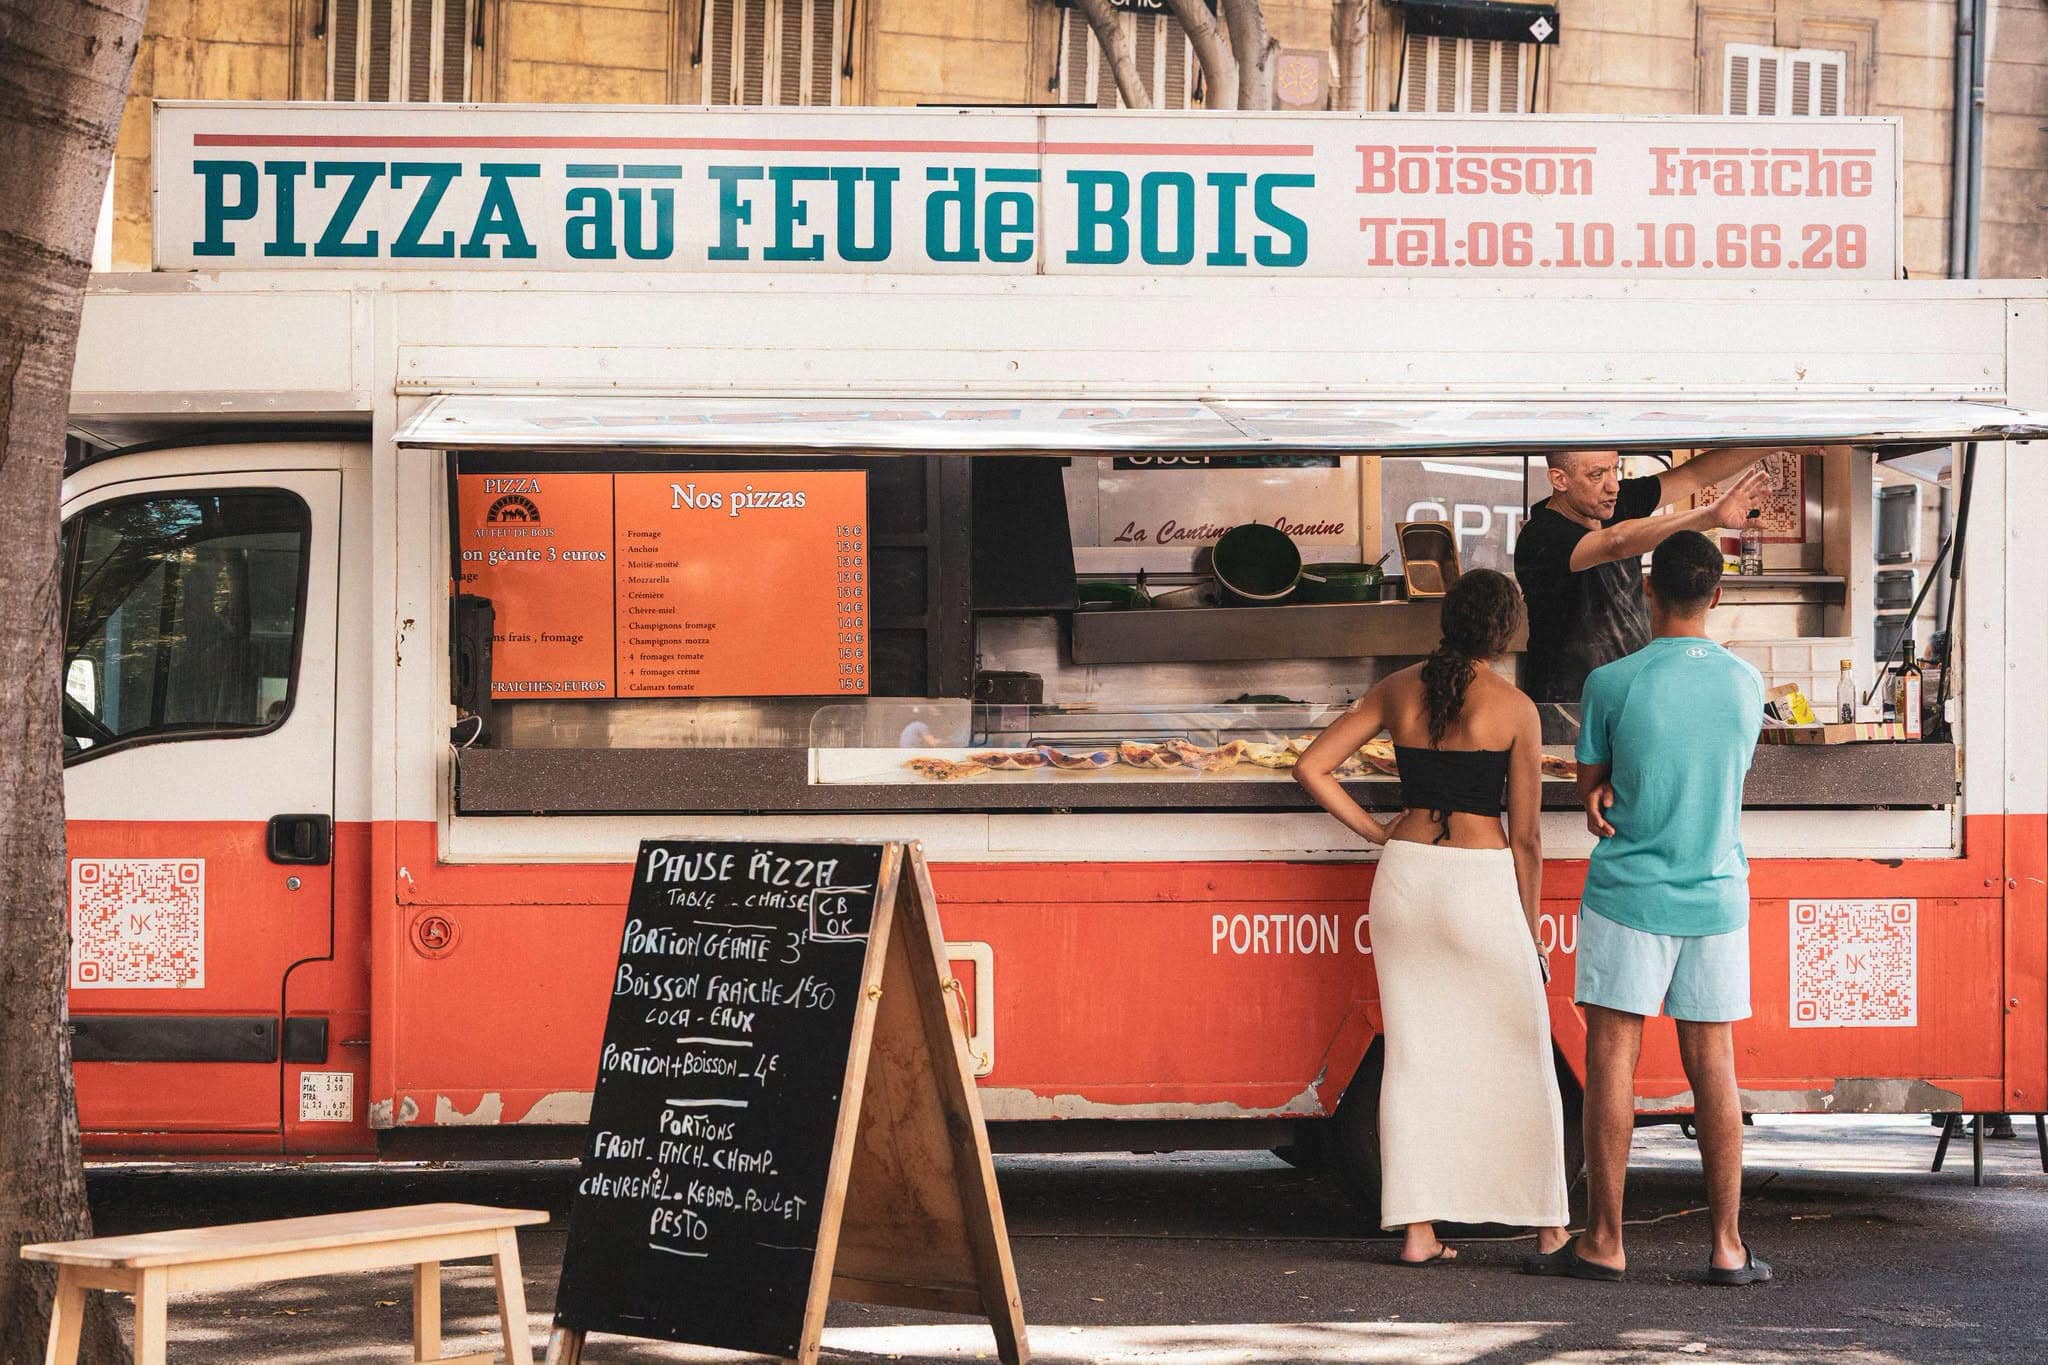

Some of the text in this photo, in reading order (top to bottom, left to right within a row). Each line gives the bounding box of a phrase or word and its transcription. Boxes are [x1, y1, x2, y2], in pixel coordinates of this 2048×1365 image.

[1355, 145, 1876, 197] Boisson Fraiche
[193, 160, 1315, 267] PIZZA au FEU de BOIS
[484, 478, 541, 493] PIZZA
[670, 482, 806, 517] Nos pizzas
[474, 528, 555, 537] AU FEU DE BOIS
[627, 530, 661, 539] Fromage
[837, 526, 850, 536] 13
[1114, 521, 1147, 542] La
[628, 545, 658, 553] Anchois
[837, 541, 851, 552] 13
[488, 546, 541, 566] géante
[546, 547, 557, 561] 3
[562, 550, 607, 561] euros
[837, 556, 851, 567] 13
[628, 576, 670, 584] Mozzarella
[837, 571, 851, 583] 13
[837, 587, 851, 598] 13
[837, 602, 851, 613] 14
[629, 622, 682, 631] Champignons
[685, 621, 716, 631] fromage
[838, 617, 852, 629] 14
[508, 632, 531, 642] frais
[541, 632, 584, 645] fromage
[629, 638, 682, 647] Champignons
[838, 632, 852, 644] 14
[629, 653, 634, 661] 4
[640, 653, 674, 662] fromages
[838, 648, 853, 659] 15
[629, 668, 634, 676] 4
[640, 668, 675, 677] fromages
[838, 663, 853, 674] 15
[555, 682, 561, 692] 2
[564, 680, 606, 692] EUROS
[629, 683, 665, 691] Calamars
[839, 678, 853, 690] 15
[646, 848, 736, 883] PAUSE
[667, 888, 716, 909] TABLE
[819, 897, 848, 916] CB
[826, 918, 853, 935] OK
[1212, 914, 1339, 955] PORTION
[645, 1007, 690, 1027] COCA
[710, 1006, 755, 1032] EAUX
[745, 1188, 807, 1221] POULET
[650, 1207, 708, 1241] PESTO
